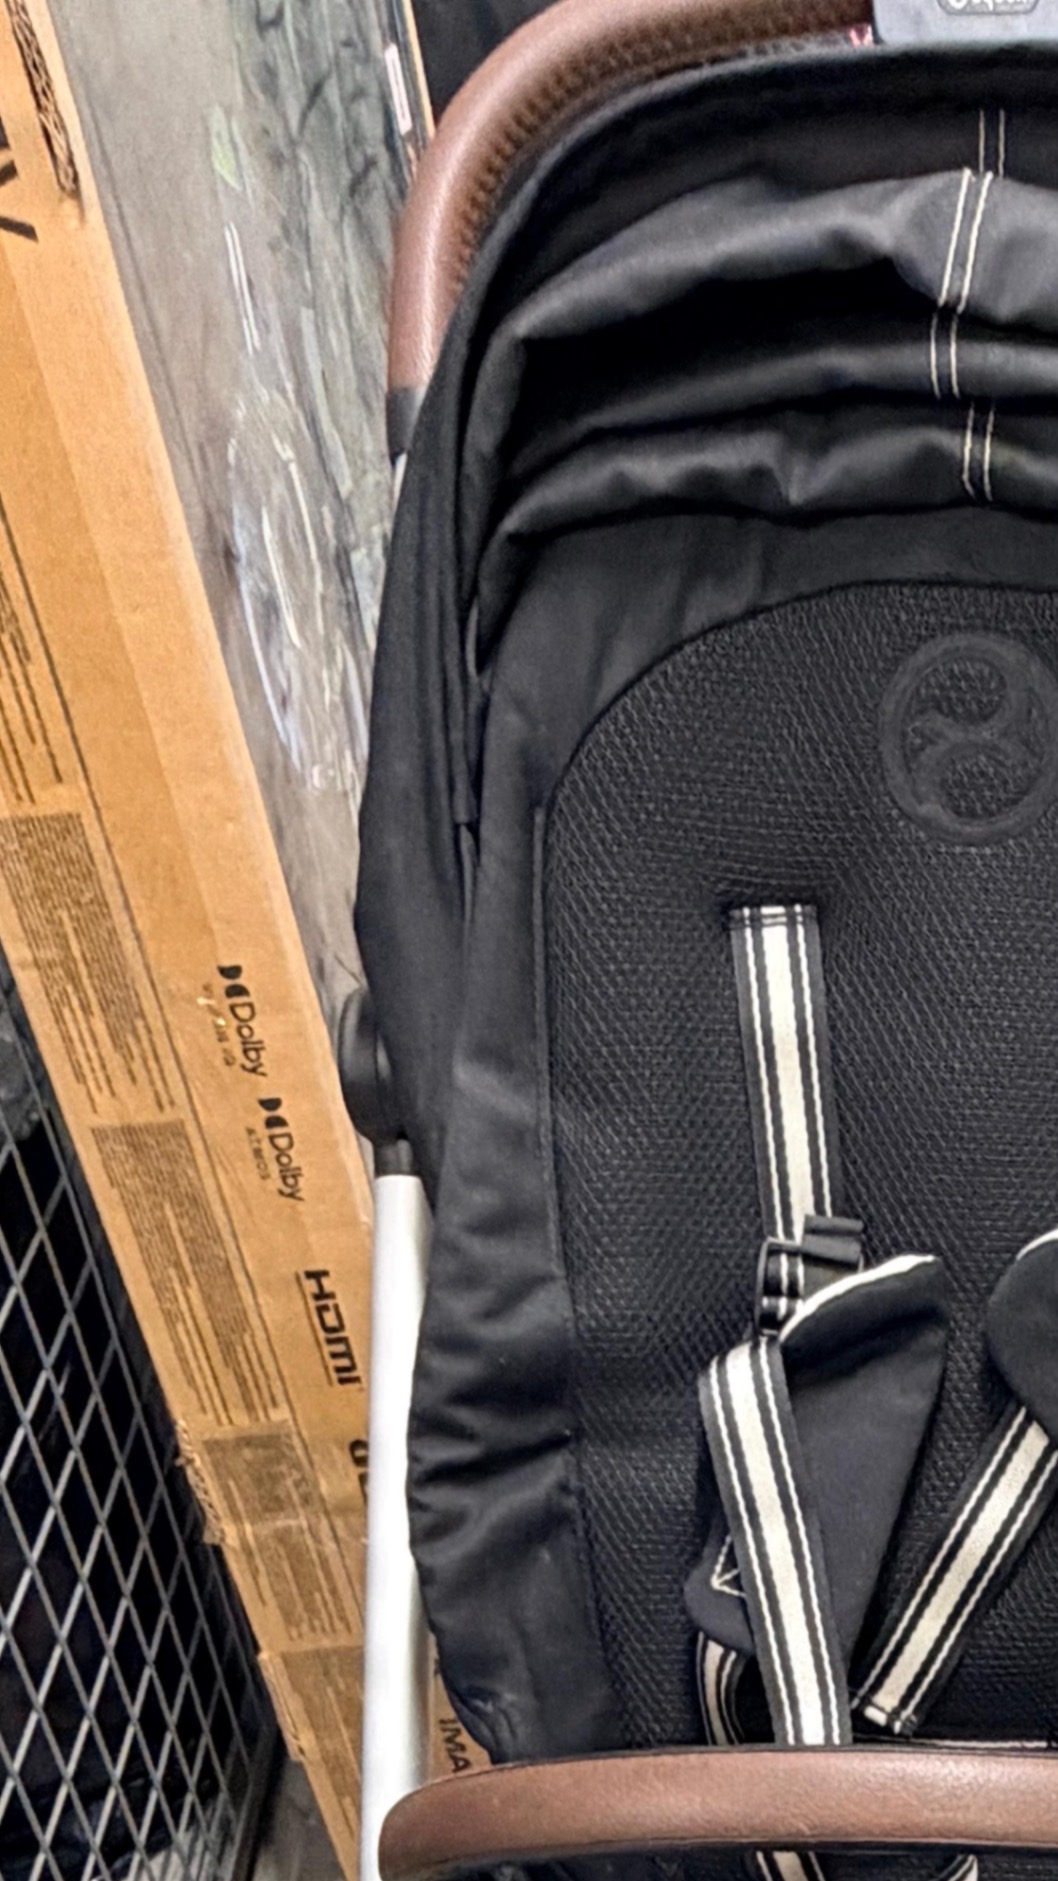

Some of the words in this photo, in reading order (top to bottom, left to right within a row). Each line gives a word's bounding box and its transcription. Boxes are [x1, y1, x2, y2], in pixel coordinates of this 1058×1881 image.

[229, 1001, 269, 1078] Dolby
[268, 1132, 305, 1202] Dolby
[303, 1269, 363, 1386] HDMI
[439, 1718, 472, 1773] IMA
